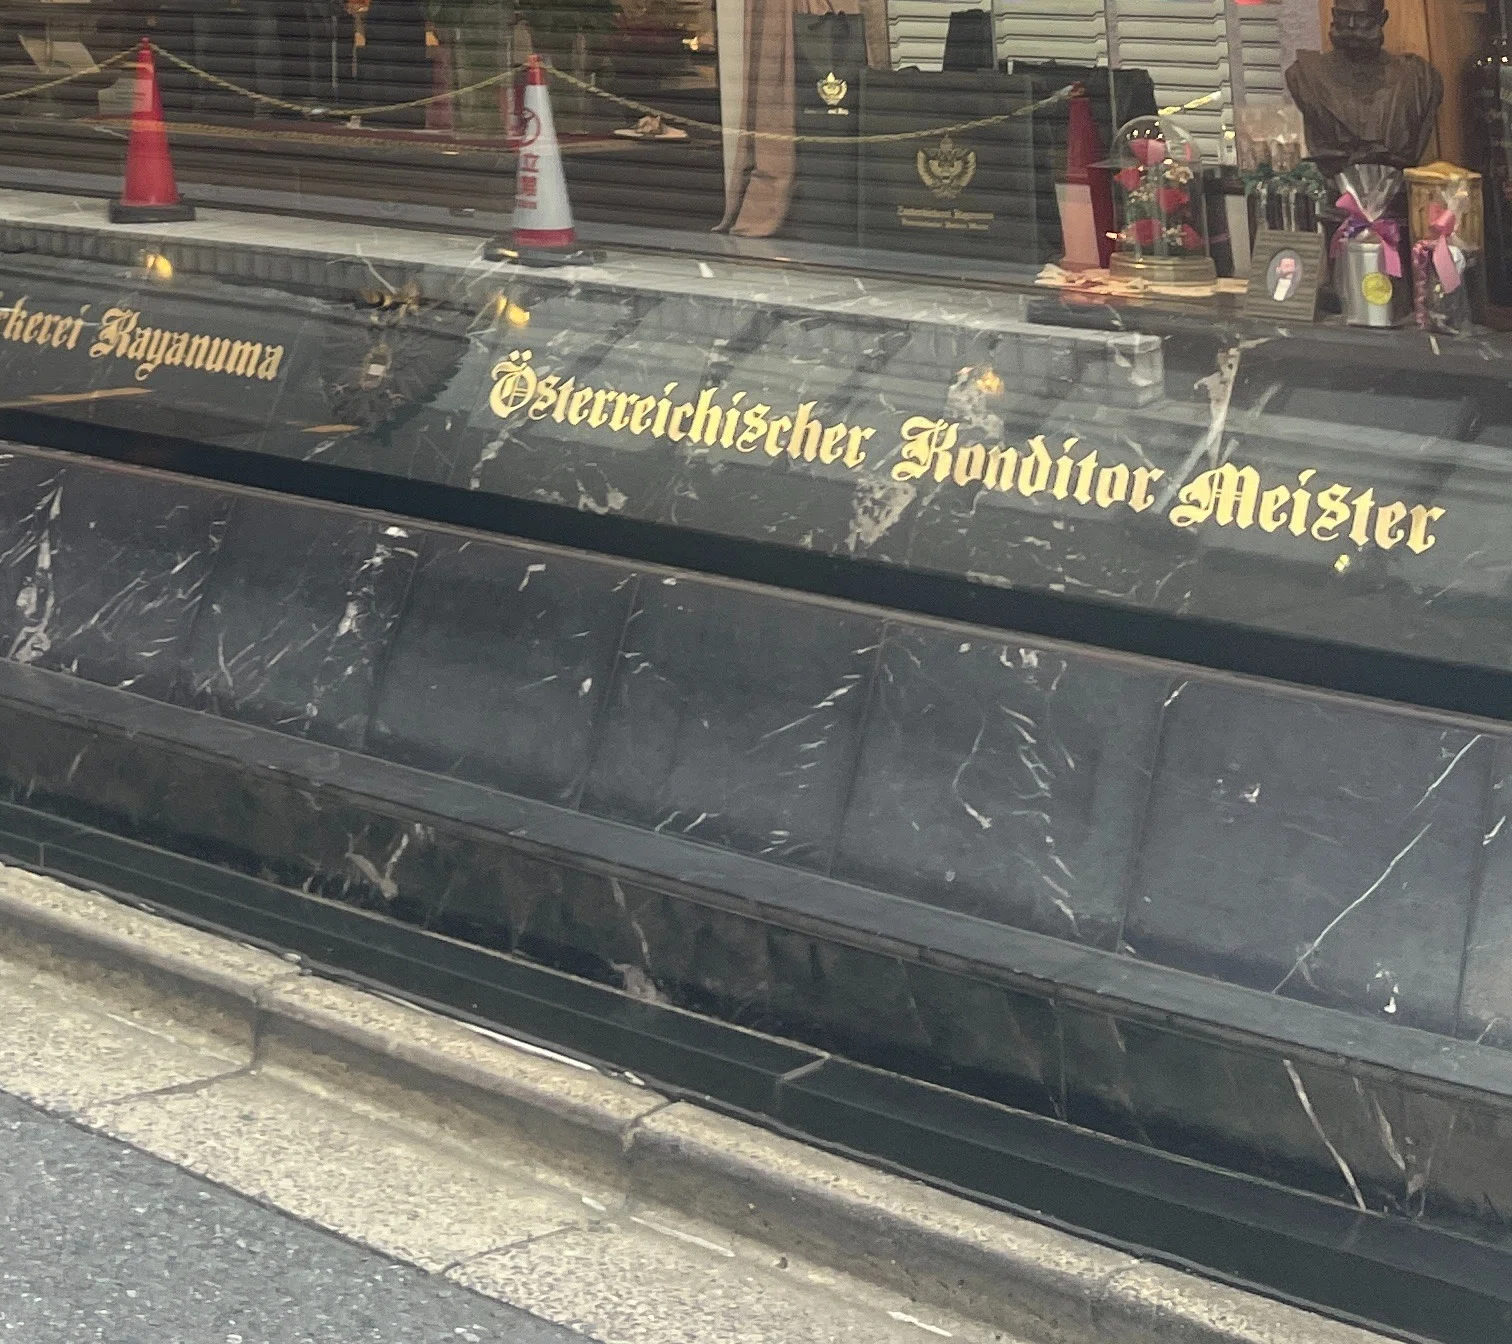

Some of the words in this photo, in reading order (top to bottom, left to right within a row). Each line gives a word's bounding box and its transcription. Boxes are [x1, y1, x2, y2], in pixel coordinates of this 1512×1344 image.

[89, 306, 285, 381] Kayanuma
[488, 351, 877, 469] Österreichischer
[891, 416, 1165, 512] Konditor
[1169, 462, 1446, 555] Meister
